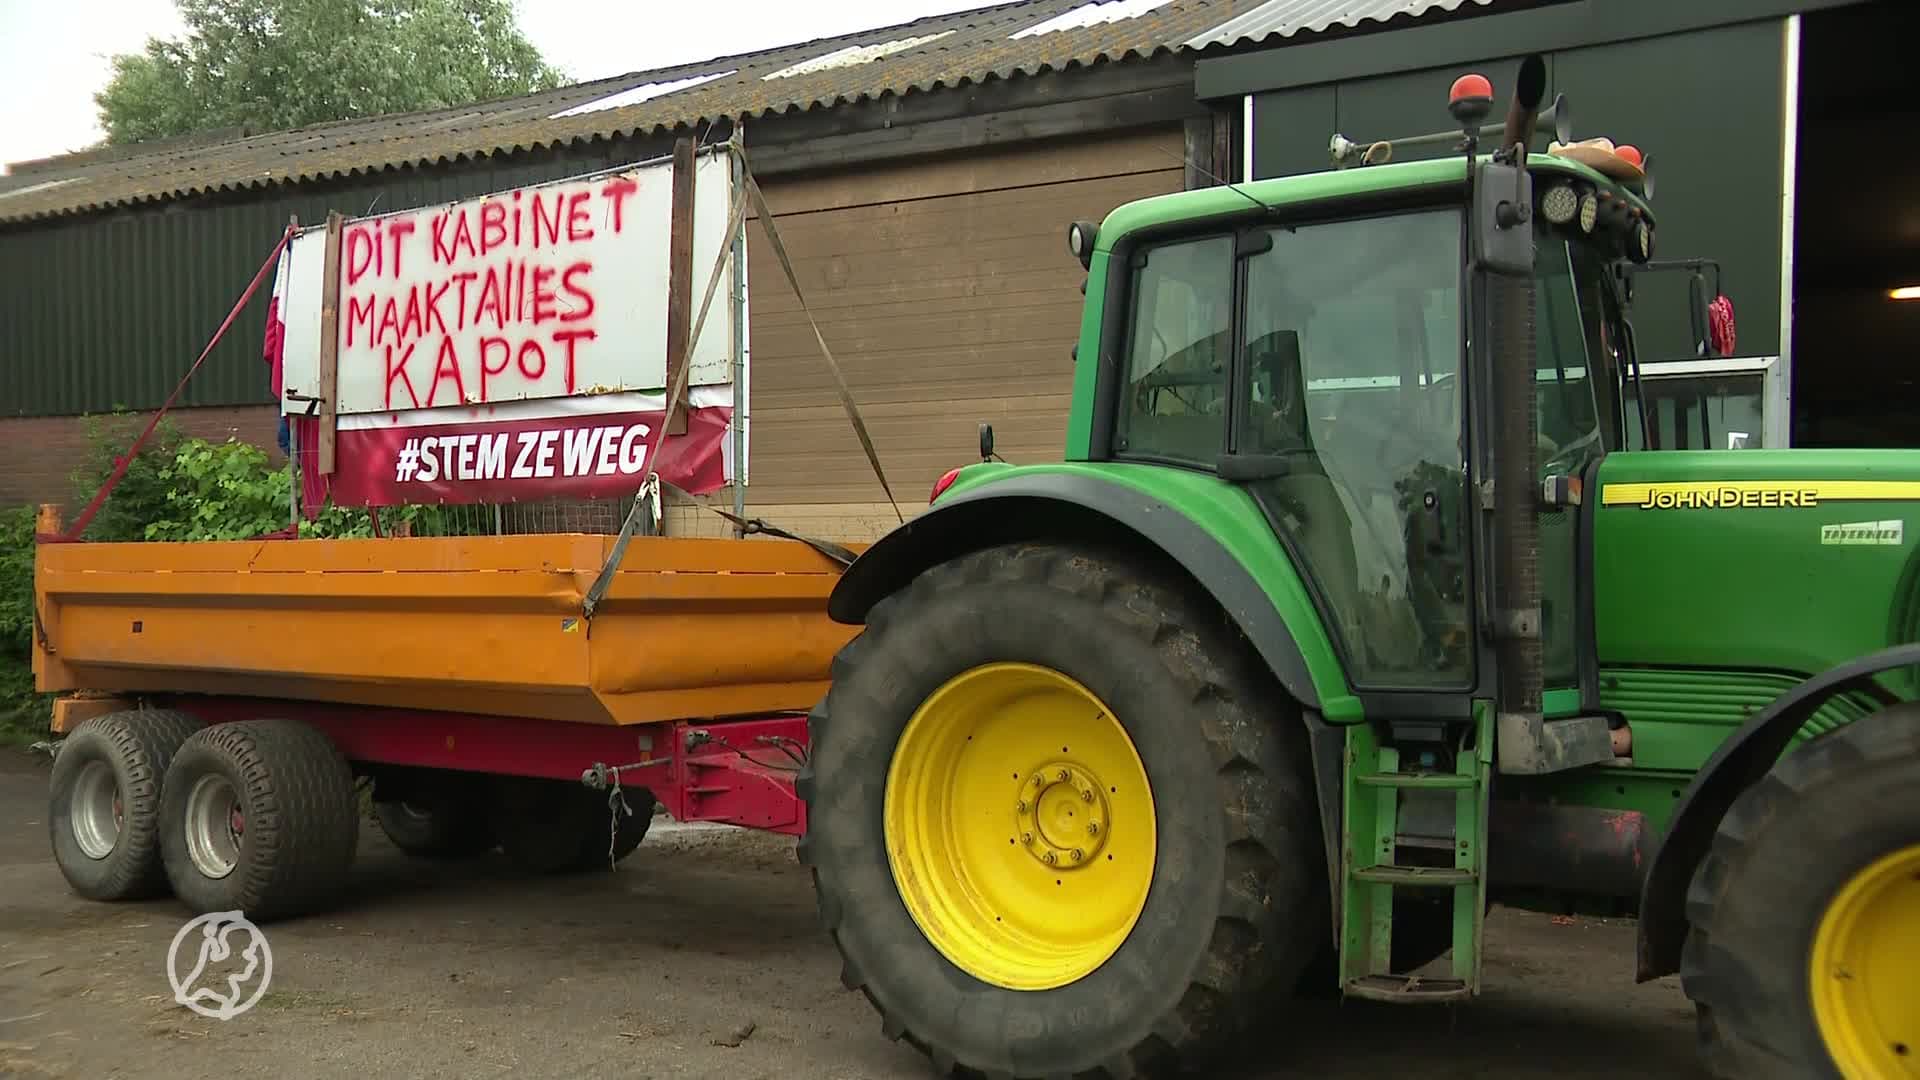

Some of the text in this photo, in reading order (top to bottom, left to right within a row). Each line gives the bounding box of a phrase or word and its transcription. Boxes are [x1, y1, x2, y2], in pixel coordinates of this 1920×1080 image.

[346, 221, 415, 286] DiT
[396, 423, 651, 483] #STEM ZE WEG
[1718, 487, 1818, 508] DEERE
